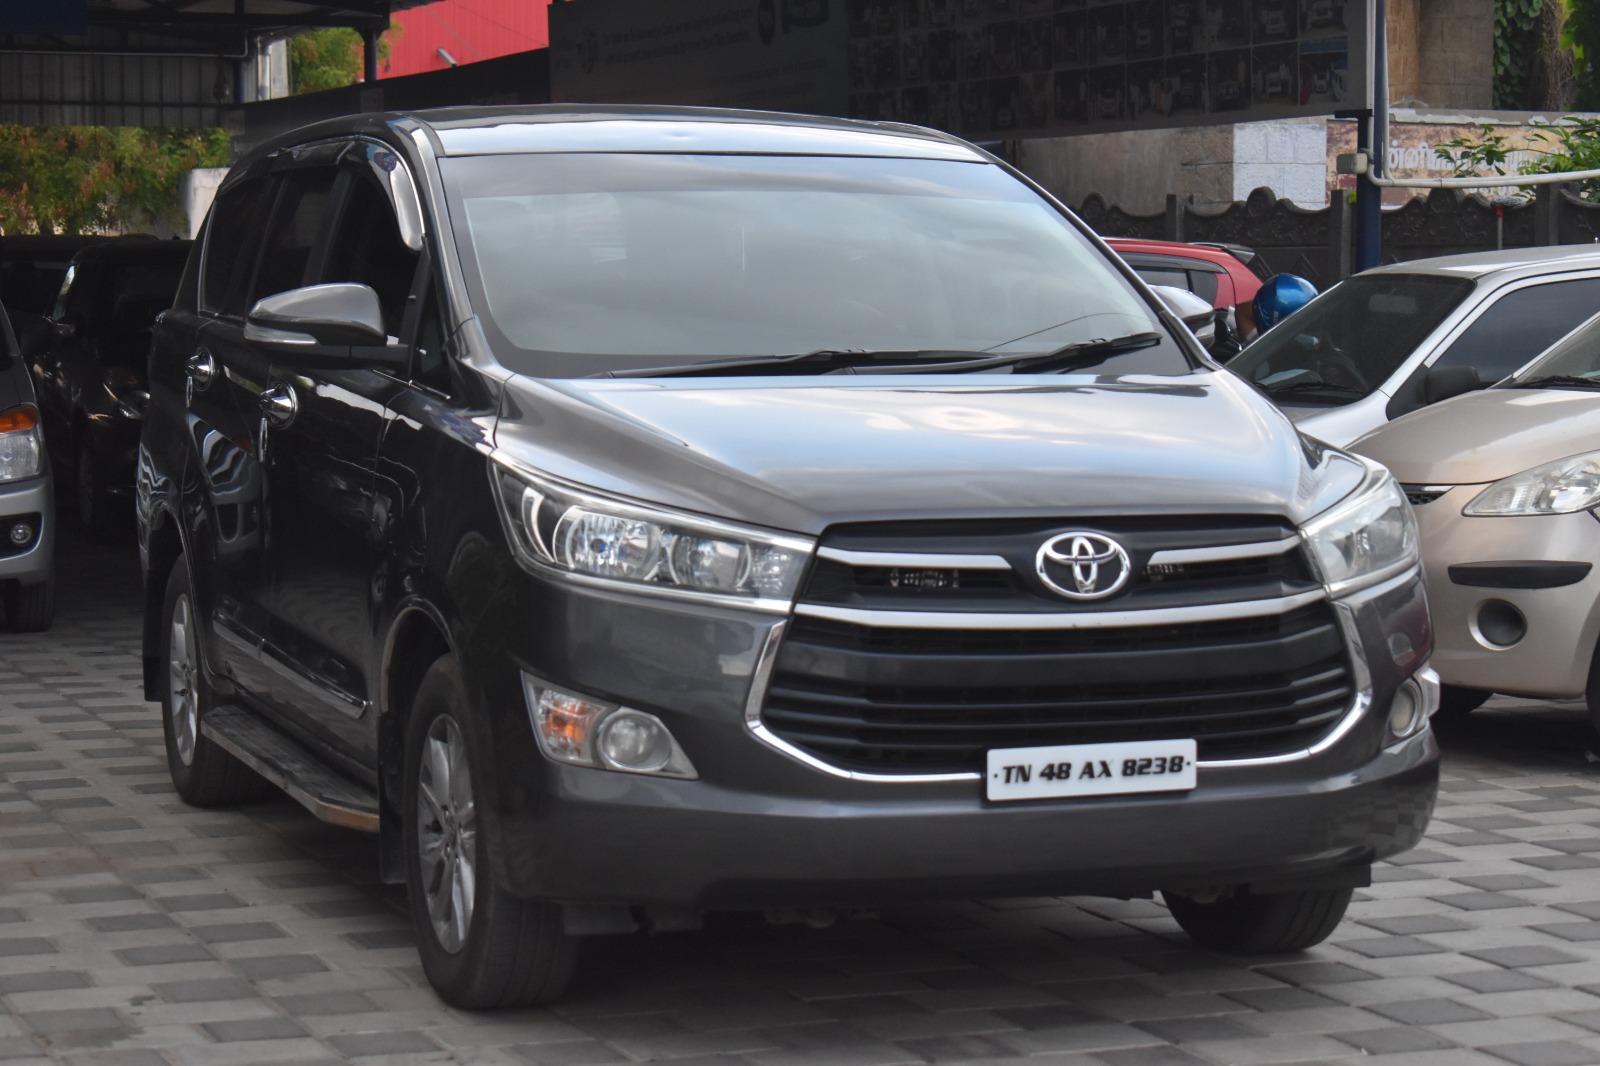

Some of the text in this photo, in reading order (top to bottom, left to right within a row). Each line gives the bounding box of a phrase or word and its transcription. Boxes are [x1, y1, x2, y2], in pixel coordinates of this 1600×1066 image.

[1002, 756, 1184, 784] TN 48 AX 8238
